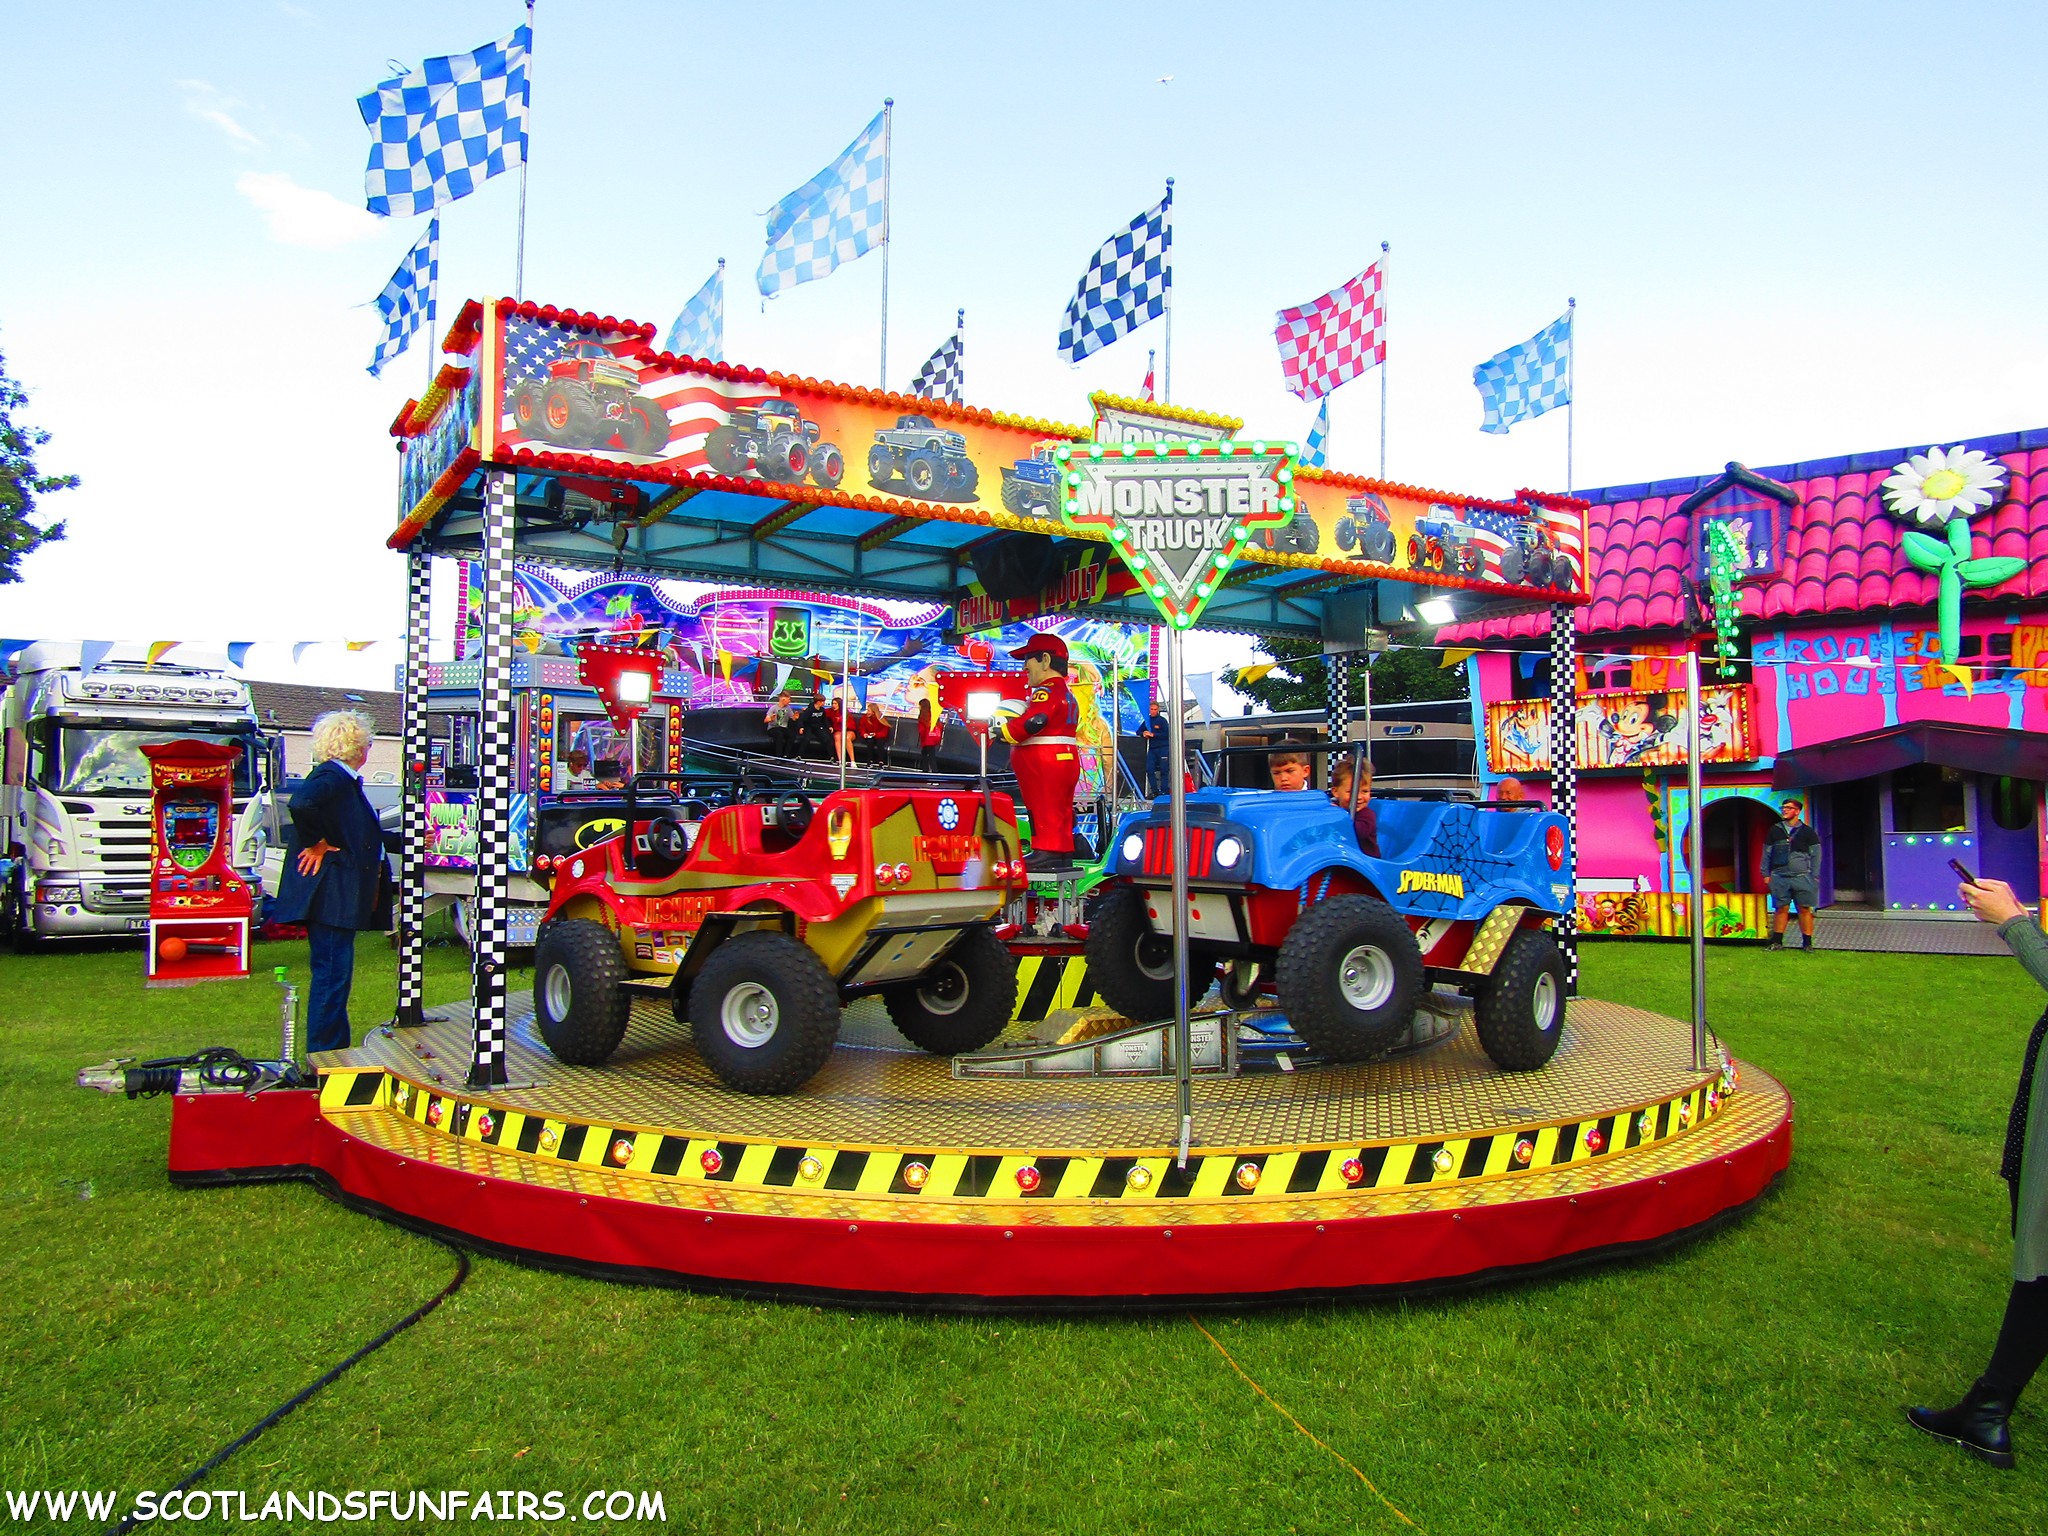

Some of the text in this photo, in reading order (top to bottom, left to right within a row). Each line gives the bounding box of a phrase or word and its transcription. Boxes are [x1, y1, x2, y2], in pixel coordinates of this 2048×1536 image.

[1077, 478, 1281, 517] MONSTER
[1127, 518, 1223, 551] TRUCK
[958, 562, 1099, 628] CHILD ADULT
[1751, 630, 1942, 667] CROOKED
[1787, 666, 1925, 700] HOUSE
[669, 704, 680, 742] PAY
[540, 693, 553, 793] PAY HERE
[429, 803, 464, 826] PUMP
[912, 835, 982, 862] IRON MAN
[1396, 869, 1465, 899] SPIDER-MAN
[644, 896, 715, 924] IRON MAN
